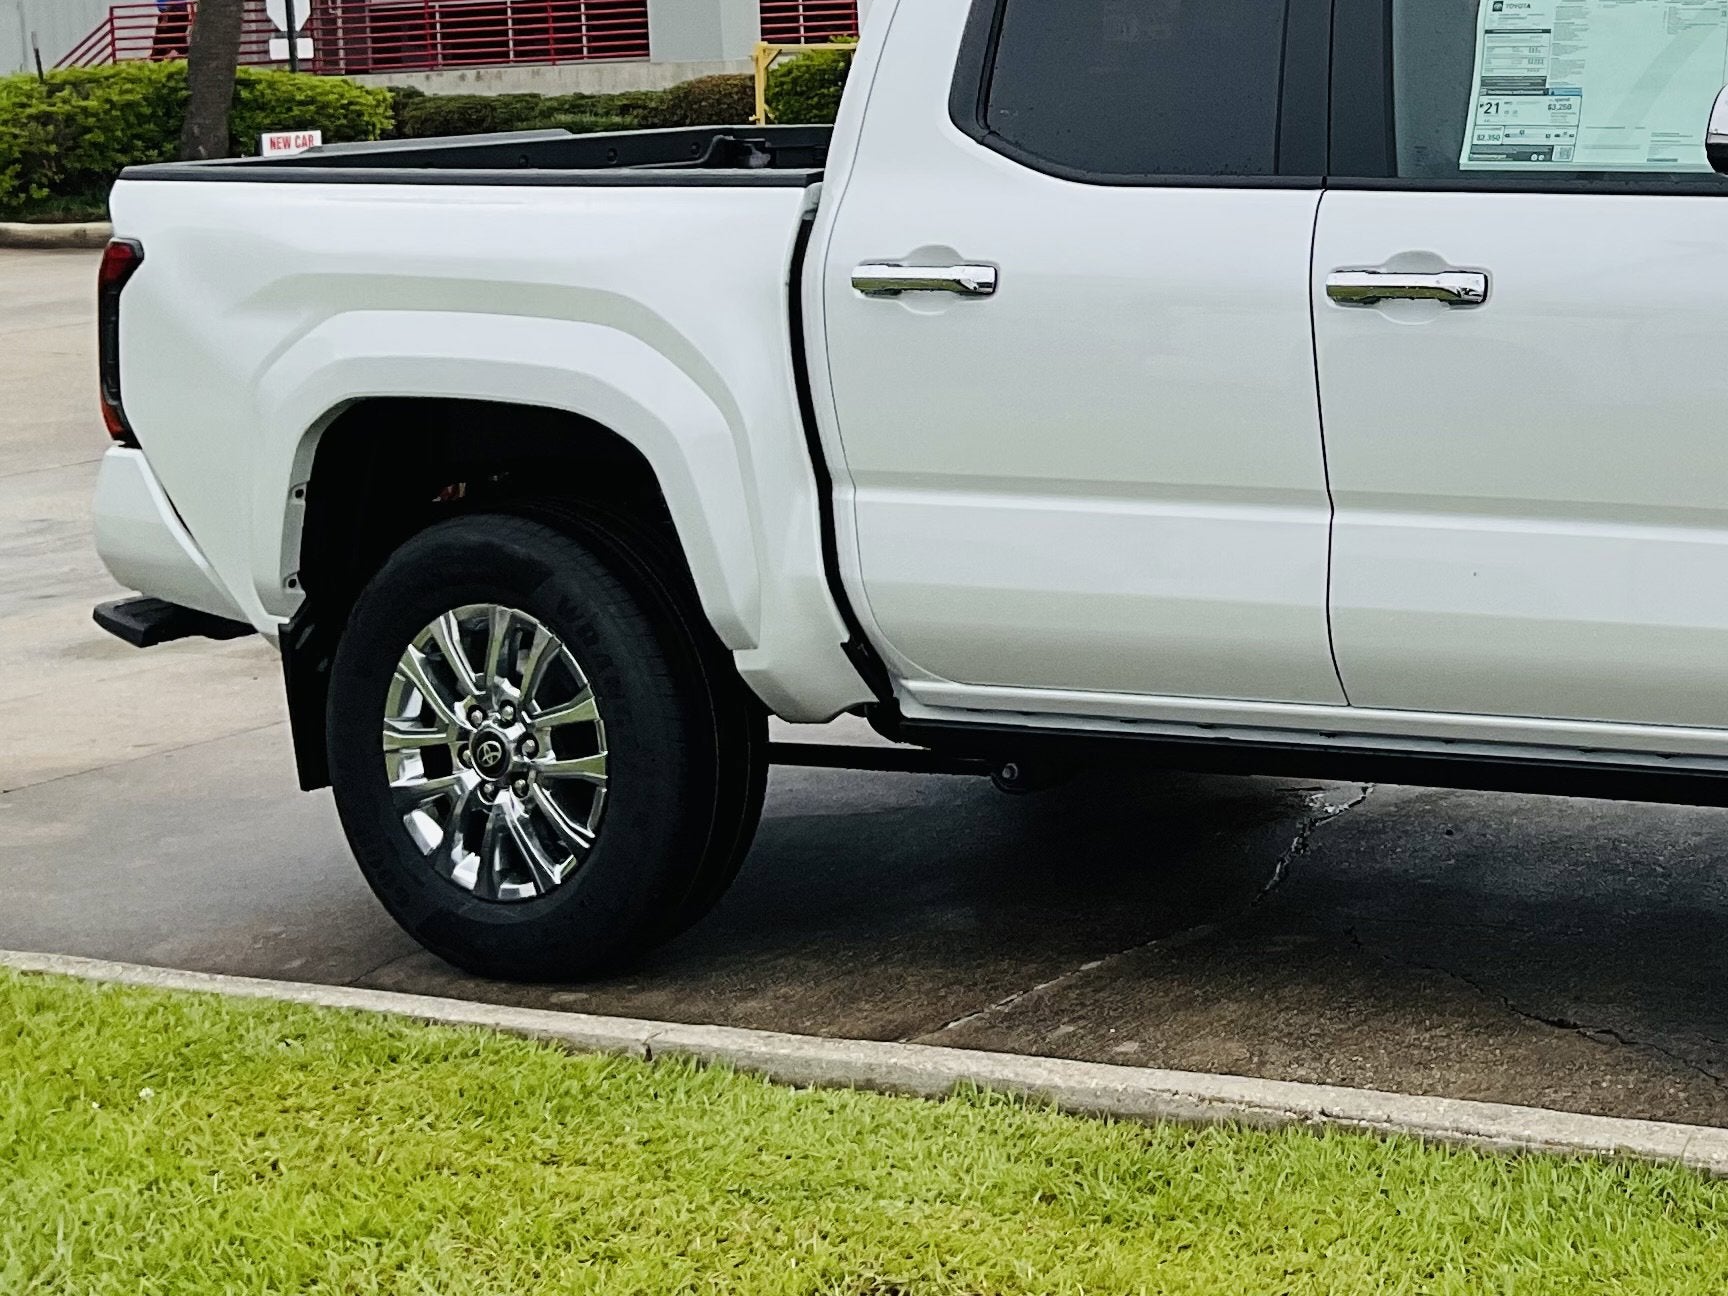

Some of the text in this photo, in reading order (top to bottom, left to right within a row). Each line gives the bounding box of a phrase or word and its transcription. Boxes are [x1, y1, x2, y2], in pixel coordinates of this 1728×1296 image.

[1483, 102, 1500, 114] 21
[270, 134, 314, 150] NEW CAR
